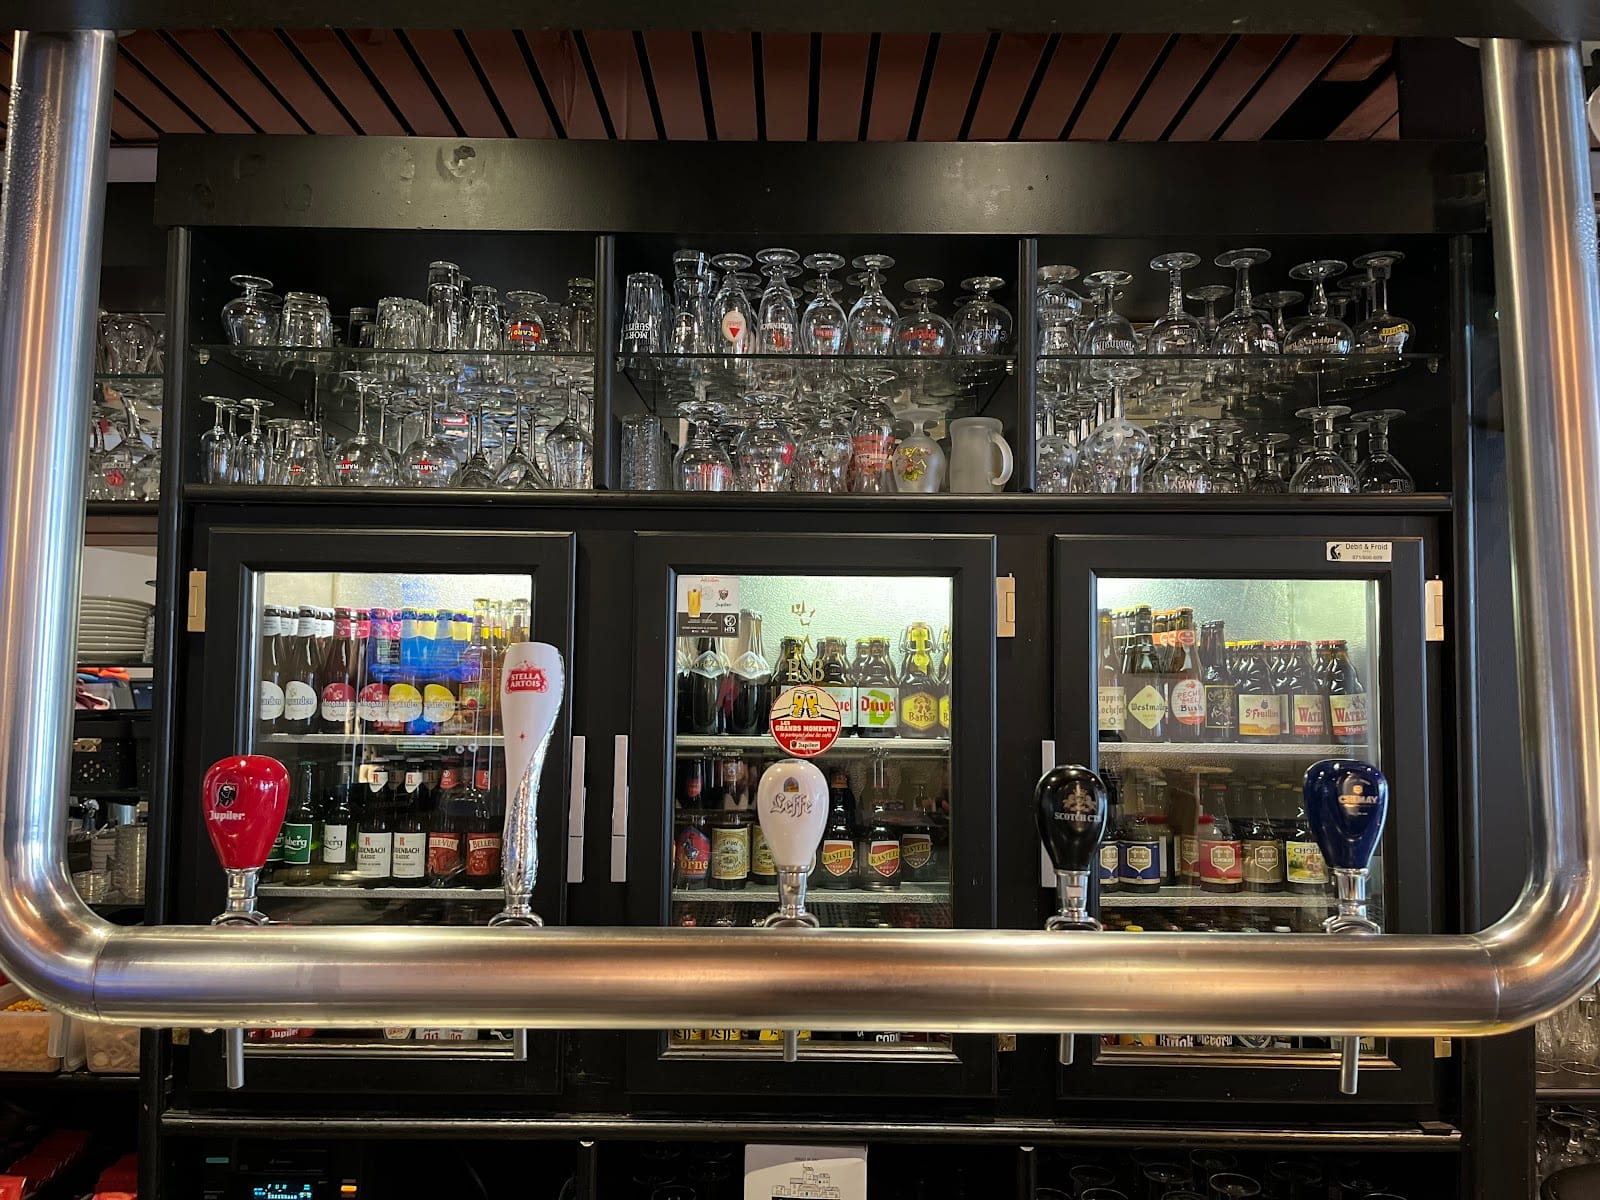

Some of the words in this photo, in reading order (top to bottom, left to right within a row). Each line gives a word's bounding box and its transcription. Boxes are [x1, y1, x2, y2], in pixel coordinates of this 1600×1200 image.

[511, 673, 540, 681] STELLA
[510, 680, 541, 688] ARTOIS
[861, 695, 896, 713] Duvel
[770, 793, 813, 818] Leffe
[1054, 812, 1087, 822] SCOTCH
[824, 850, 852, 862] KASTEEL
[871, 849, 899, 863] KASTEEL
